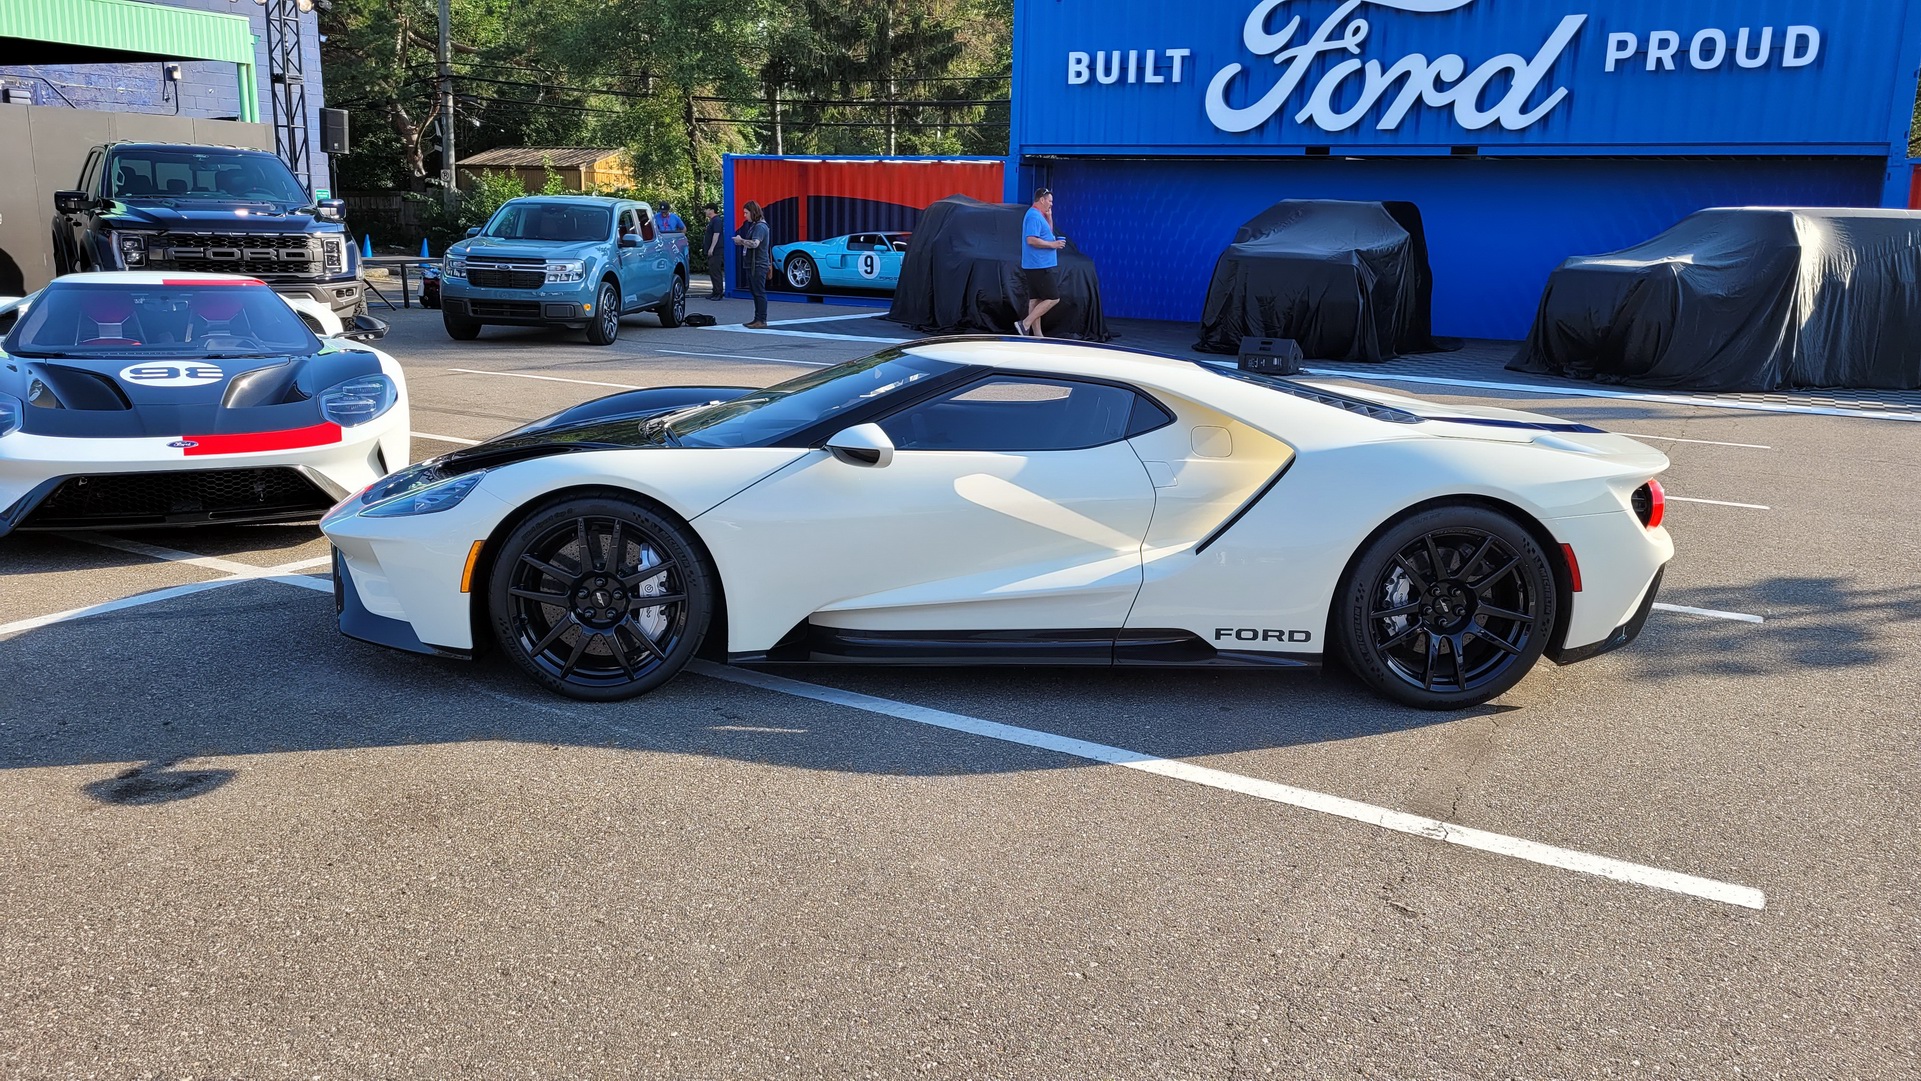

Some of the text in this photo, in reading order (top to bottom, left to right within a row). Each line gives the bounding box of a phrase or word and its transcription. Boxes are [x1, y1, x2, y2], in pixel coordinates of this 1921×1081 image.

[1068, 0, 1820, 132] BUILT Ford PROUD
[165, 248, 311, 262] FORD
[864, 255, 874, 275] 9
[129, 366, 224, 380] 98
[659, 528, 690, 568] MICHELIN
[1539, 567, 1552, 614] MICHELIN
[1214, 628, 1312, 643] FORD
[1353, 605, 1370, 655] MICHELIN
